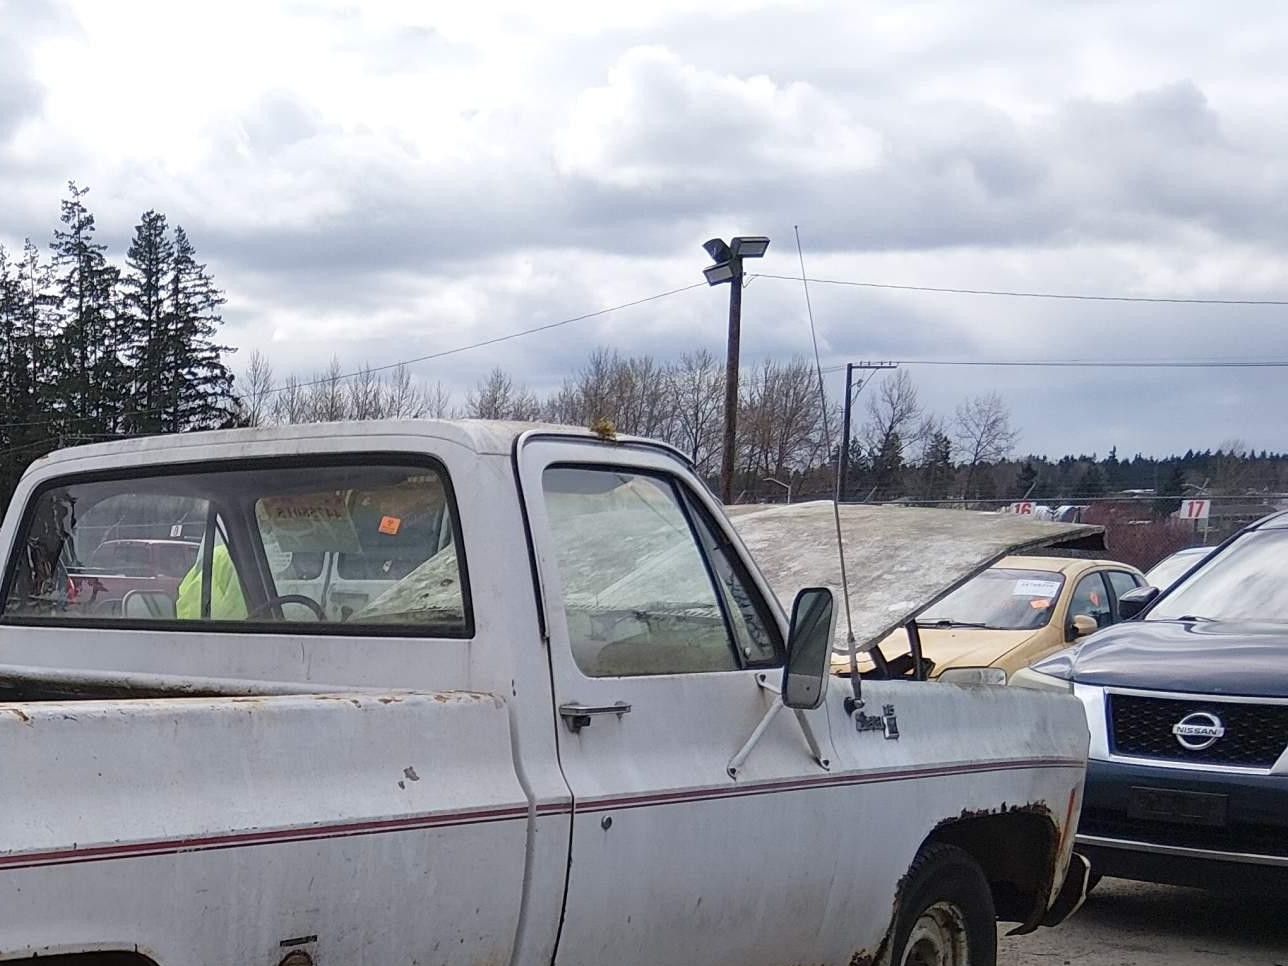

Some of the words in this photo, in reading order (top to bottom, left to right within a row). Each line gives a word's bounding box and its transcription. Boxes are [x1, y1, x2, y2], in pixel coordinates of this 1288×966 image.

[1015, 503, 1031, 514] 16
[1187, 501, 1205, 517] 17
[1176, 726, 1218, 736] NISSAN
